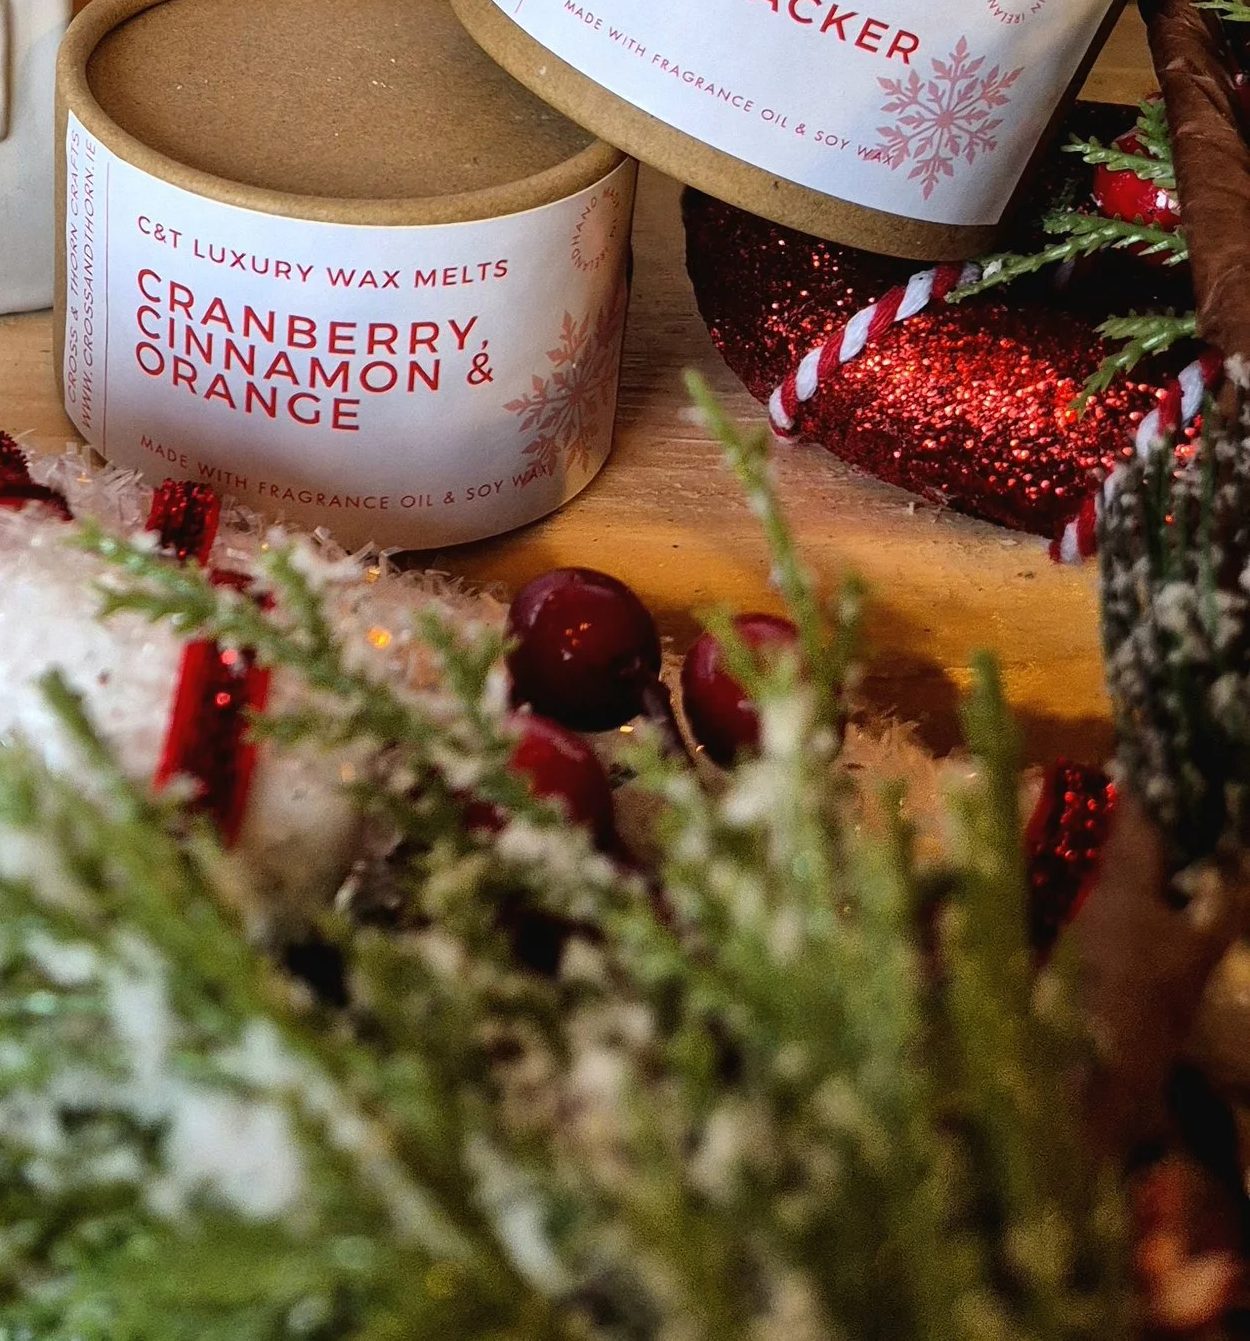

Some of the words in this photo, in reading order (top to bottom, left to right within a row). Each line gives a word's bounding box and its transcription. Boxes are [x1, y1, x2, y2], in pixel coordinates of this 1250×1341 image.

[608, 26, 647, 58] WITH
[651, 53, 754, 113] FRAGRANCE
[760, 108, 790, 129] OIL
[794, 123, 807, 136] &
[813, 130, 851, 151] SOY
[857, 144, 895, 167] WAX
[70, 130, 80, 216] CRAFTS
[70, 222, 79, 296] THORN
[82, 139, 96, 428] WWW.CROSSANDTHORN.IE
[137, 215, 182, 249] C&T
[193, 238, 314, 282] LUXURY
[326, 267, 401, 289] WAX
[414, 259, 509, 288] MELTS
[70, 306, 79, 321] &
[136, 304, 441, 394] CINNAMON
[466, 351, 494, 386] &
[137, 268, 489, 355] CRANBERRY,
[68, 326, 78, 403] CROSS
[135, 340, 361, 431] ORANGE
[140, 435, 189, 469] MADE
[197, 462, 248, 490] WITH
[259, 481, 389, 510] FRAGRANCE
[401, 495, 433, 508] OIL
[443, 491, 456, 504] &
[466, 480, 503, 500] SOY
